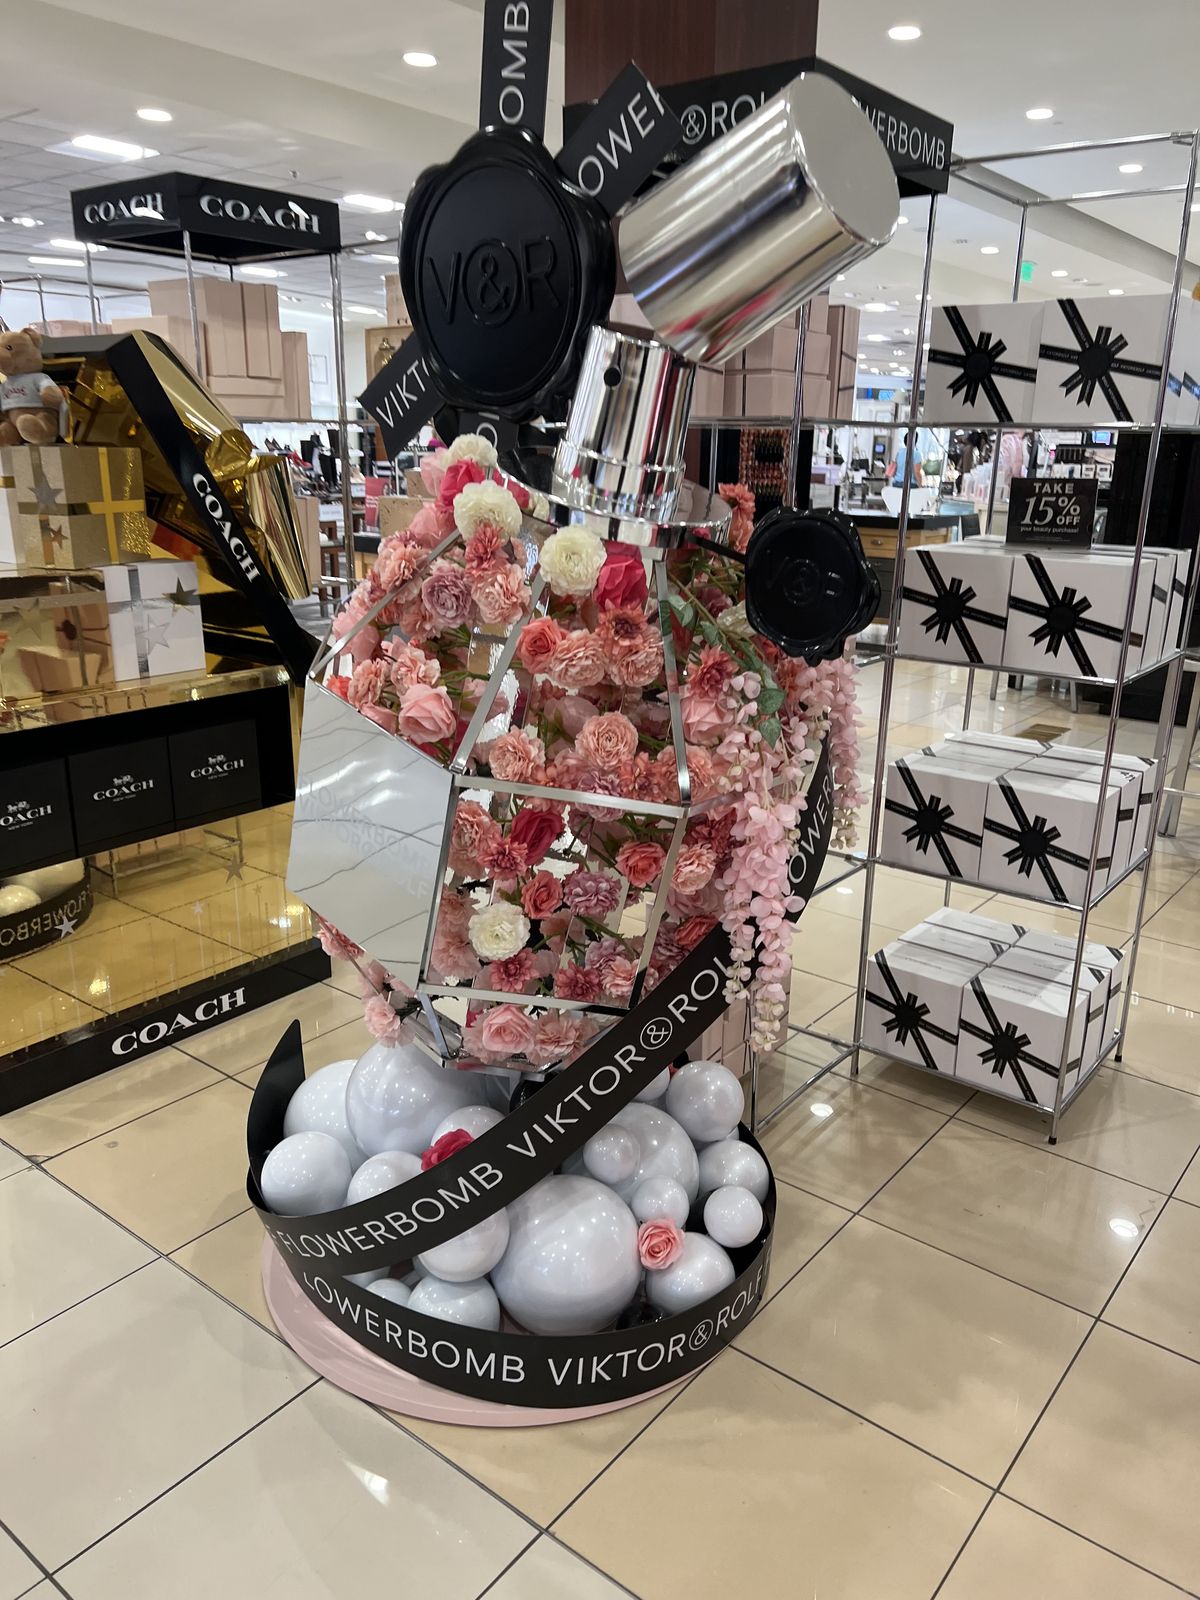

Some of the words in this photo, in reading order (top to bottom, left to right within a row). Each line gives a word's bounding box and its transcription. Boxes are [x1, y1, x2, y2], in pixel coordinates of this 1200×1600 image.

[83, 191, 165, 225] COACH
[200, 194, 321, 235] COACH
[427, 233, 563, 328] V&R
[375, 356, 431, 429] VIKT
[1020, 496, 1081, 526] 15%
[1056, 515, 1081, 526] OFF
[1033, 482, 1075, 494] TAKE
[192, 472, 261, 583] COACH
[93, 779, 155, 801] COACH
[190, 759, 245, 779] COACH
[111, 987, 247, 1056] COACH
[276, 1162, 504, 1258] FLOWERBOMB
[303, 1271, 526, 1384] LOWERBOMB
[547, 1264, 763, 1387] VIKTOR&ROLF
